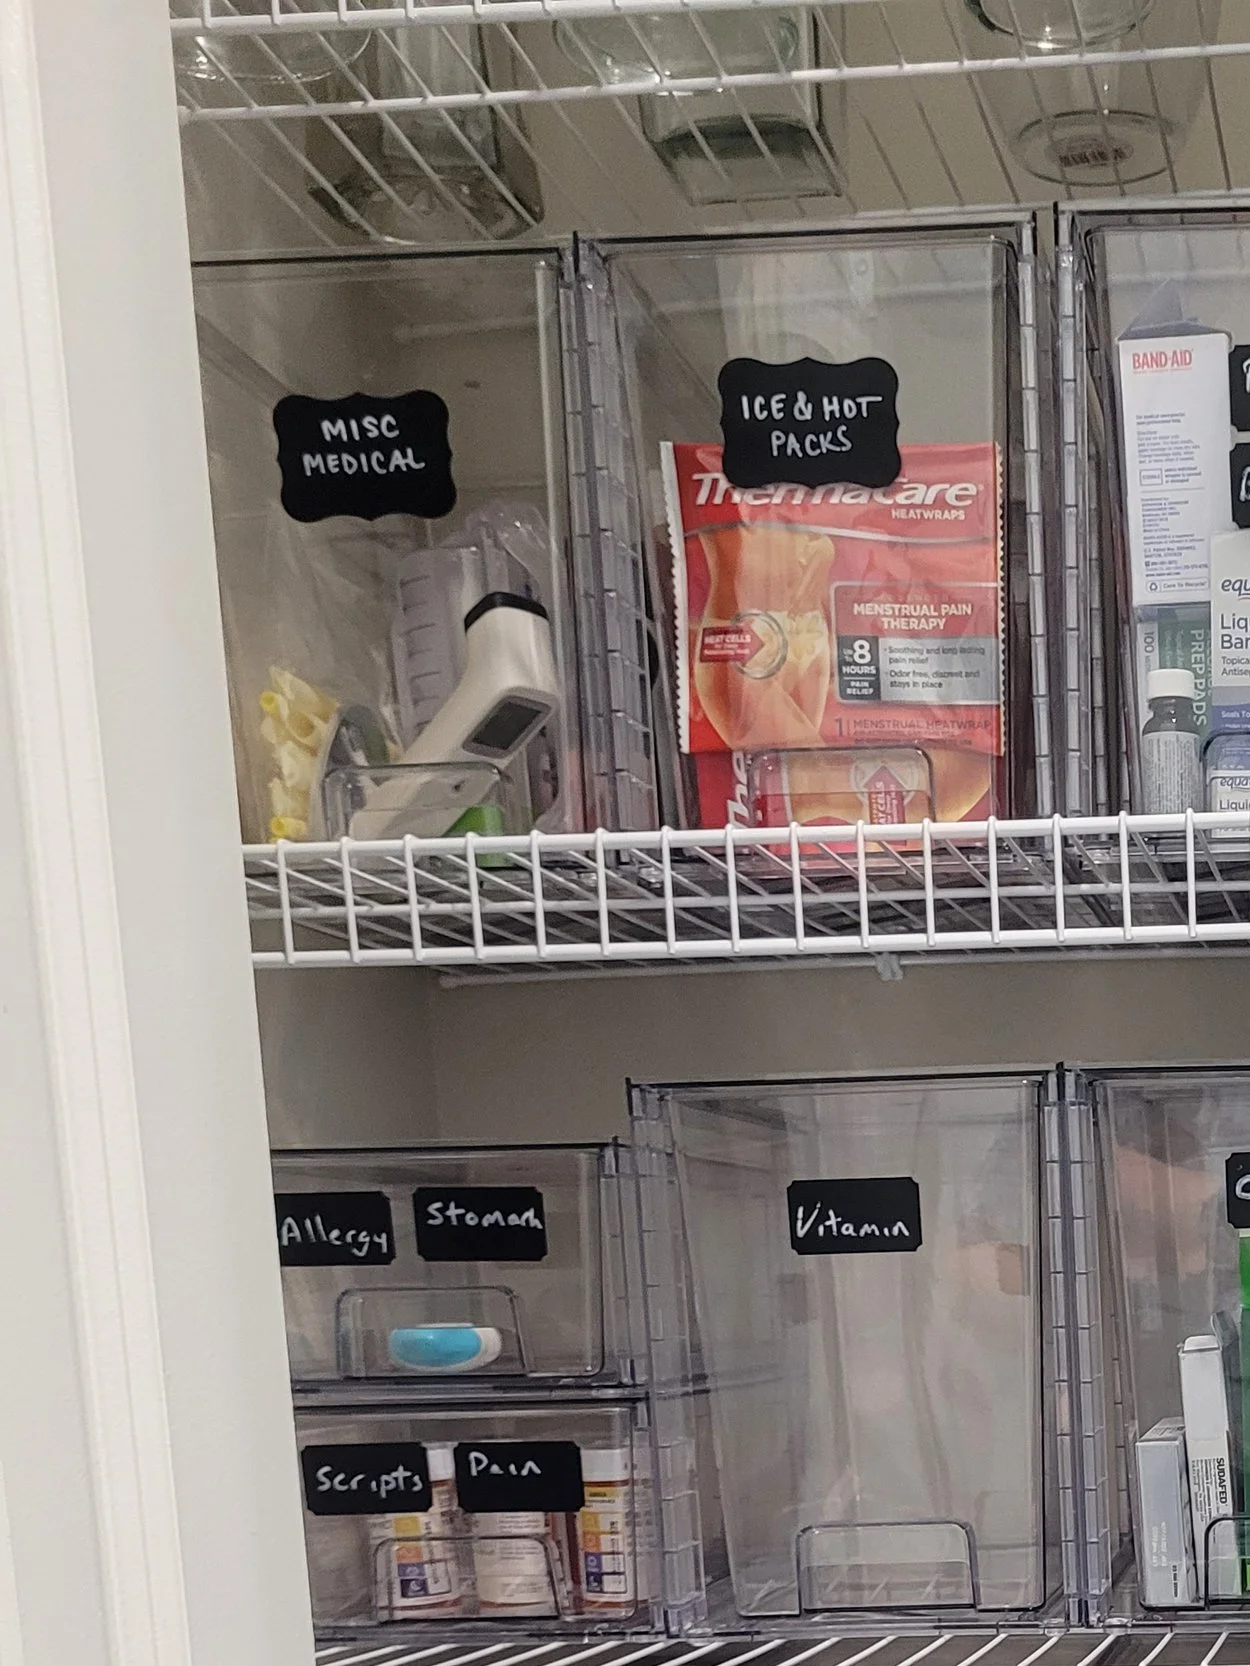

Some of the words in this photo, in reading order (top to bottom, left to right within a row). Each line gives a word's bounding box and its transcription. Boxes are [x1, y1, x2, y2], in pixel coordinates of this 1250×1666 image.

[741, 394, 787, 421] ICE
[793, 391, 813, 421] &
[823, 395, 883, 421] HOT
[321, 414, 400, 442] MISC
[771, 425, 853, 458] PACKS
[302, 447, 426, 476] MEDICAL
[891, 508, 965, 521] HEATWRAPS
[853, 603, 938, 617] MENSTRUAL
[941, 602, 972, 616] PAIN
[881, 617, 946, 630] THERAPY
[853, 639, 872, 664] 8
[1190, 629, 1206, 674] PREP
[842, 665, 877, 675] HOURS
[796, 1200, 910, 1239] Vitamin
[281, 1213, 388, 1257] Allergy
[468, 1451, 542, 1477] Pain
[316, 1465, 425, 1499] Scripts
[1216, 1457, 1228, 1504] SUDAFED
